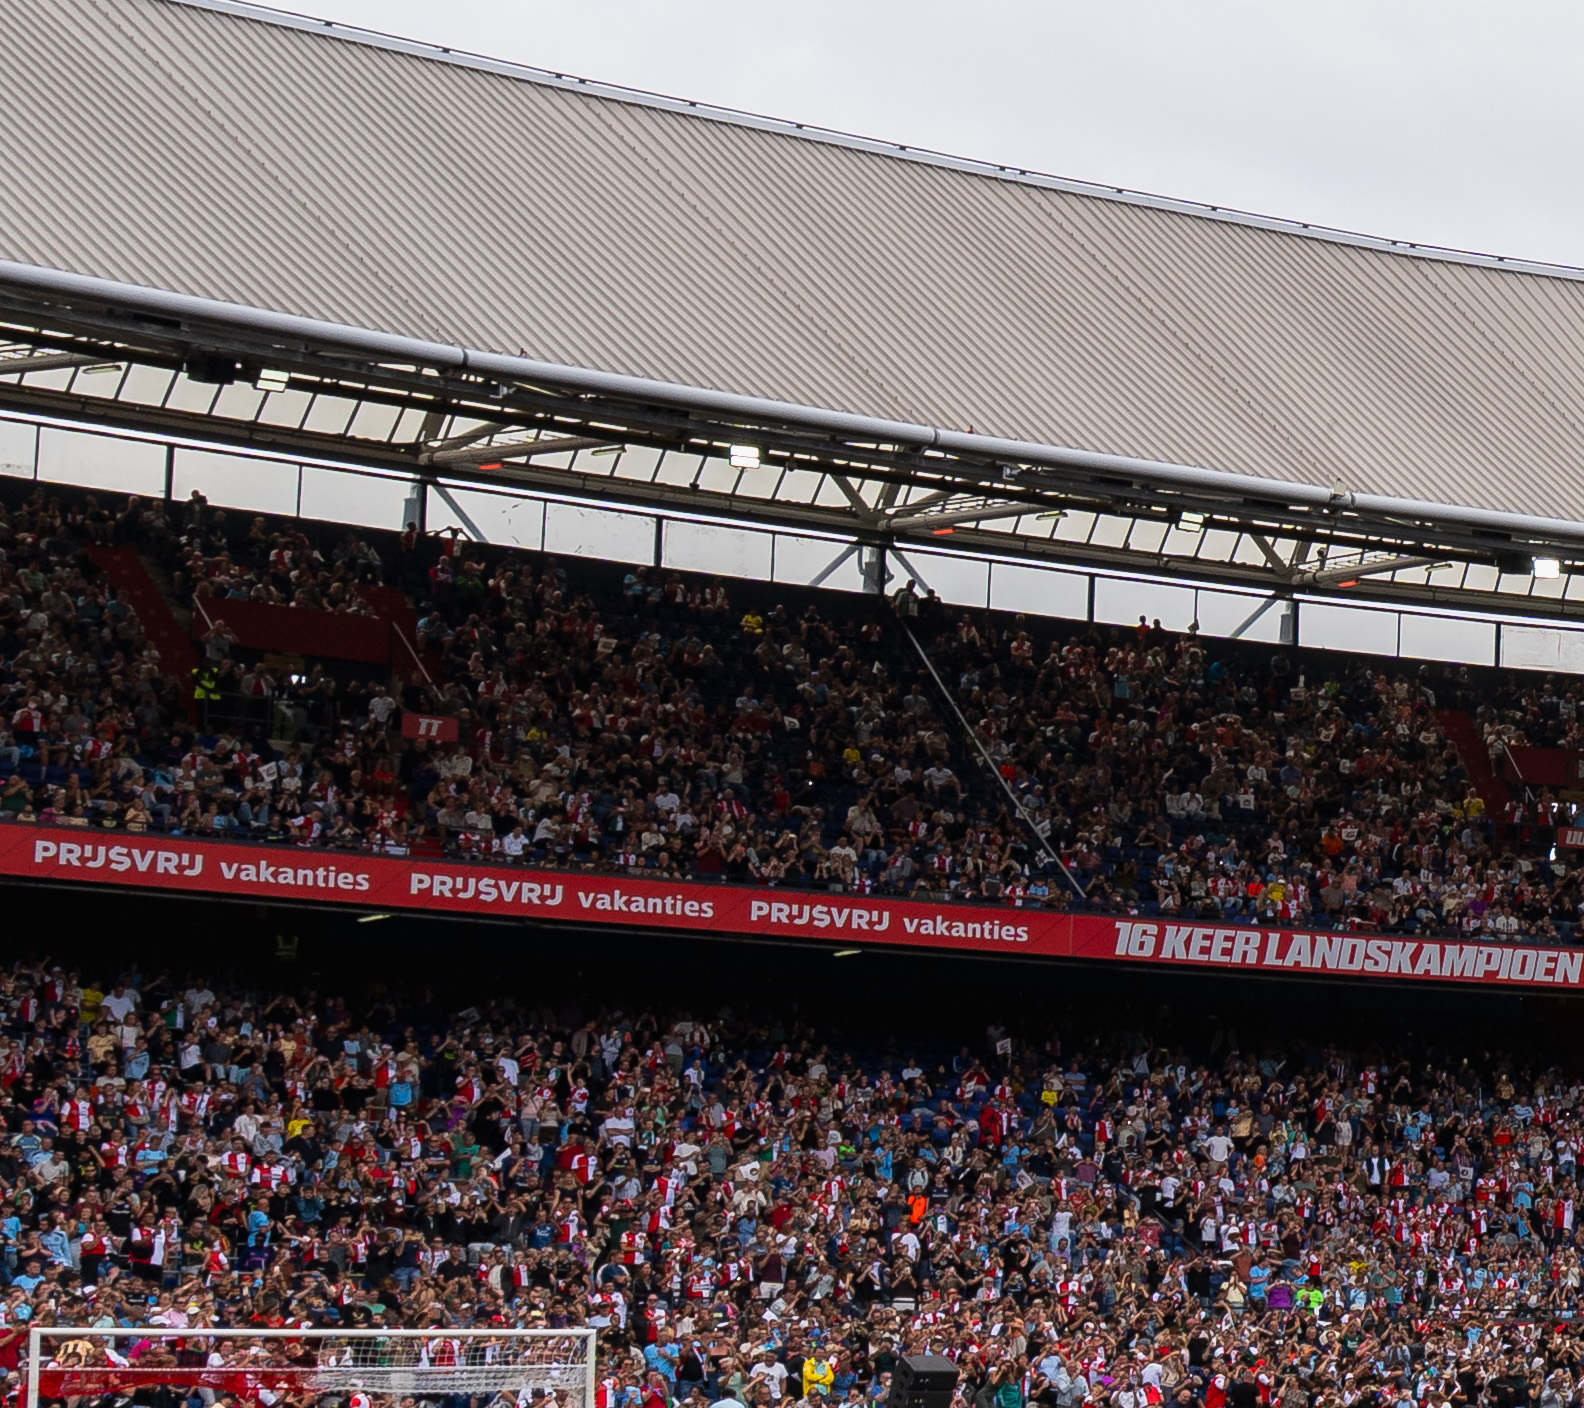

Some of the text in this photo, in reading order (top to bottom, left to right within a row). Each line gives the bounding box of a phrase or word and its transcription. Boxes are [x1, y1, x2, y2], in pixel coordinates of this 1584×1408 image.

[419, 718, 443, 736] TT
[220, 860, 370, 892] vakanties
[578, 889, 714, 919] vakanties
[902, 916, 1029, 942] vakanties
[1114, 921, 1583, 984] 16 KEER LANDSKAMPIOEN
